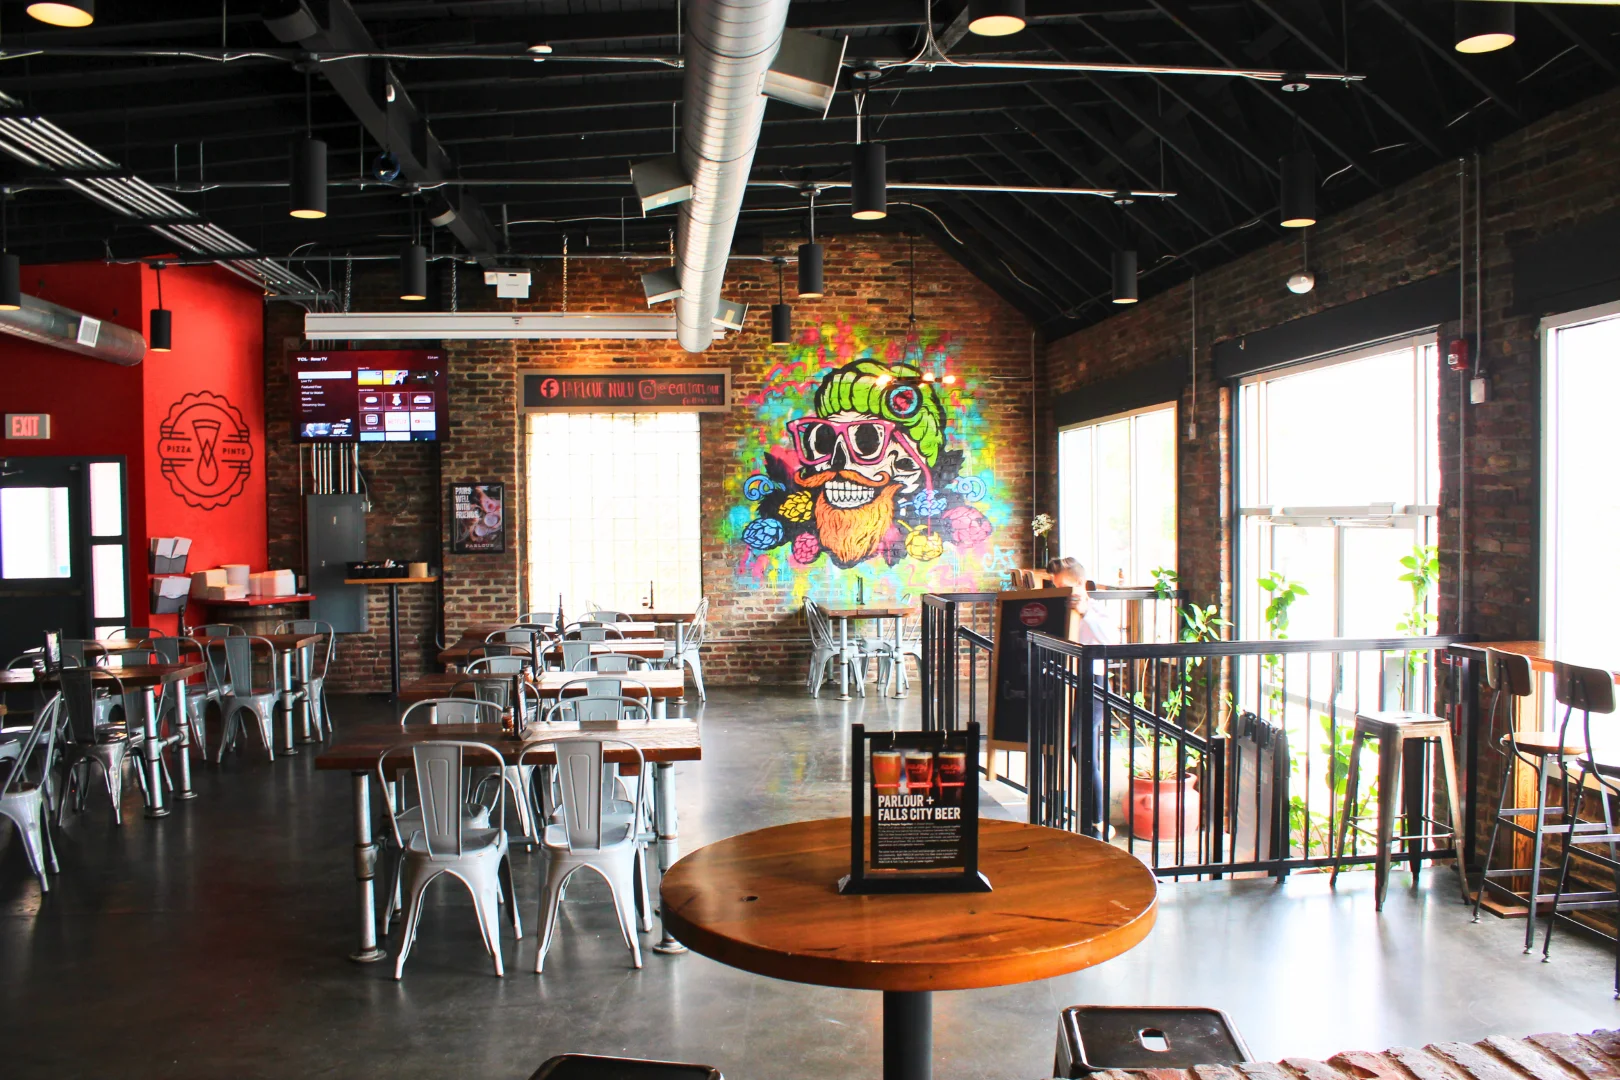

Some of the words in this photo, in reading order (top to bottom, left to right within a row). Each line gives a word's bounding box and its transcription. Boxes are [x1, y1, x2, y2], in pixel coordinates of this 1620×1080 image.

[12, 415, 39, 437] EXIT
[167, 445, 192, 453] PIZZA
[222, 447, 246, 456] PINTS
[455, 495, 470, 503] WELL
[878, 794, 924, 808] PARLOUR
[878, 808, 908, 821] FALLS
[909, 807, 933, 820] CITY
[935, 807, 961, 820] BEER
